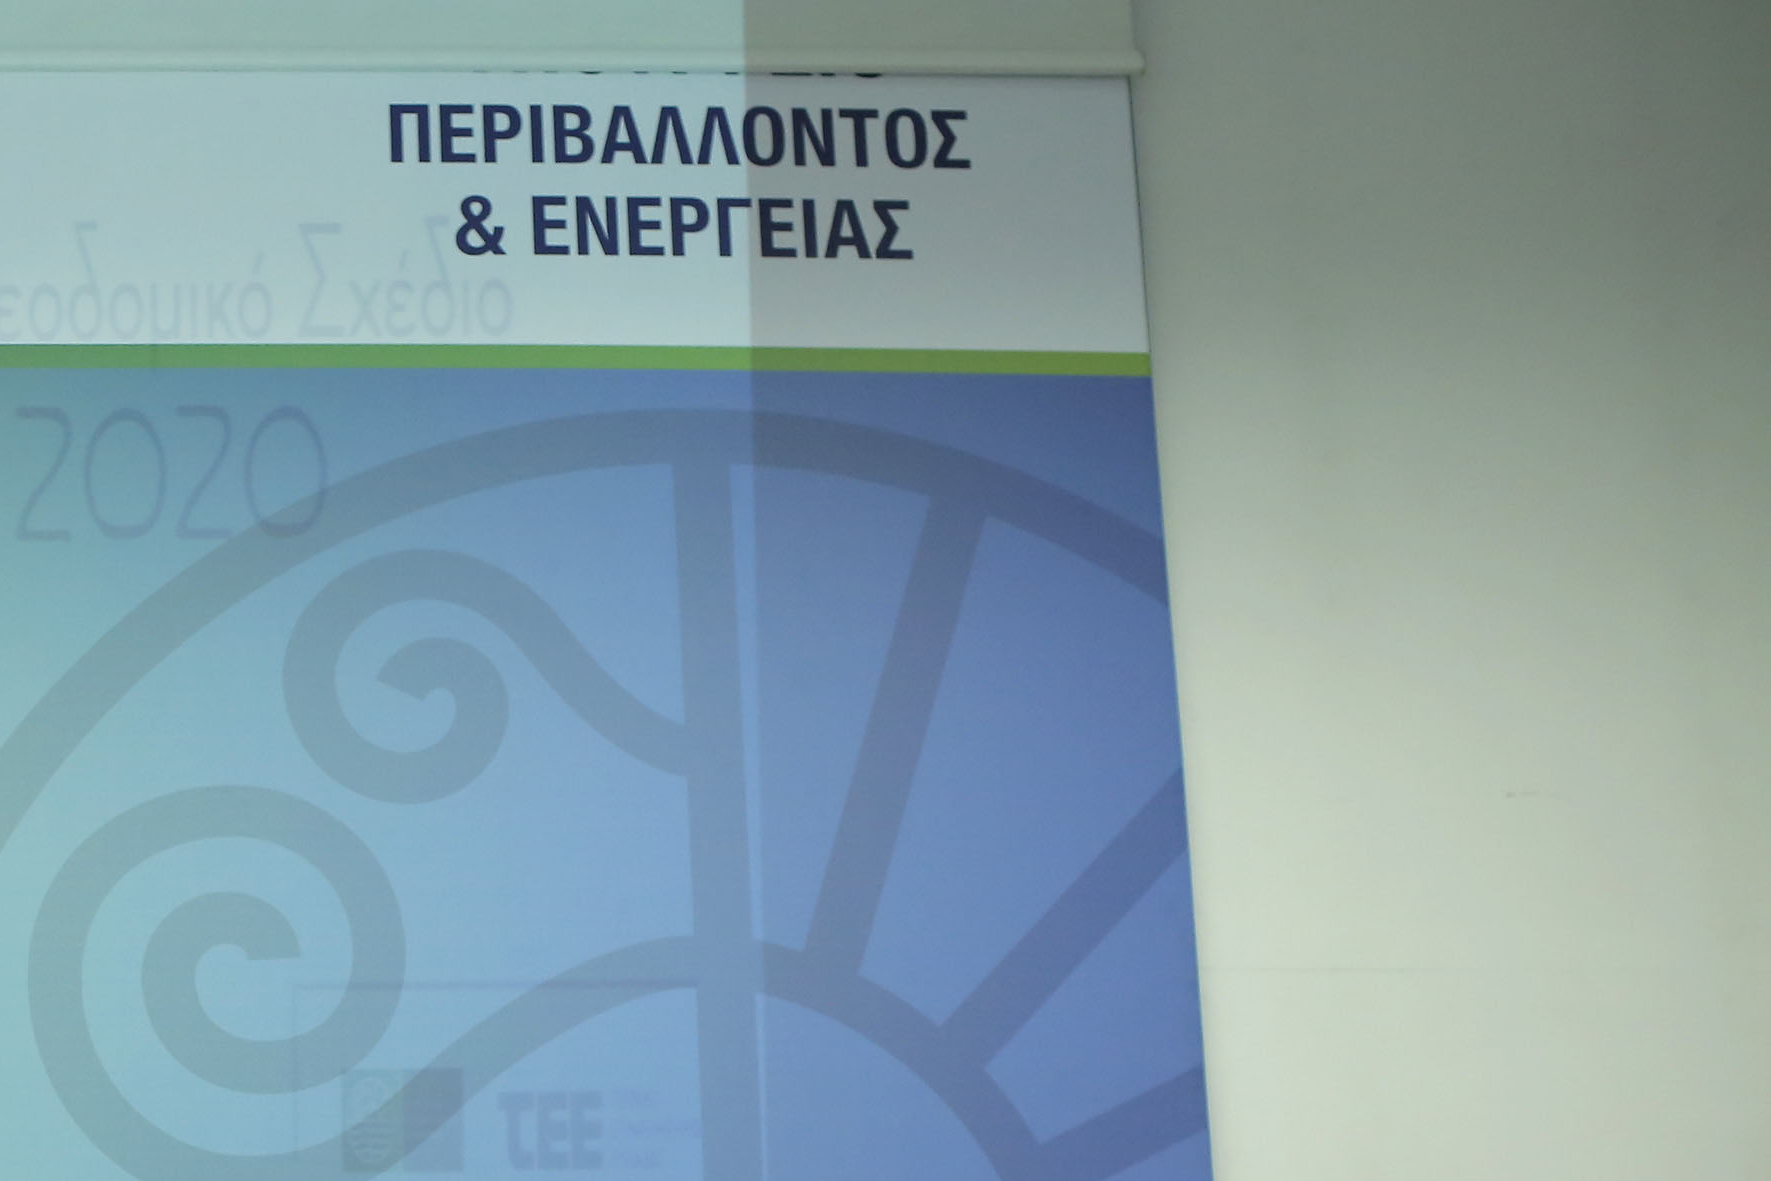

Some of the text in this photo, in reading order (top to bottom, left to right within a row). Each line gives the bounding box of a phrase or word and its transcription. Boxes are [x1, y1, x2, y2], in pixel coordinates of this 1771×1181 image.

[388, 103, 972, 170] ΠΕΡΙΒΑΛΛΟΝΤΟΣ
[455, 194, 914, 260] & ΕΝΕΡΓΕΙΑΣ
[297, 214, 515, 338] Σχέδιο
[14, 404, 329, 543] 2020
